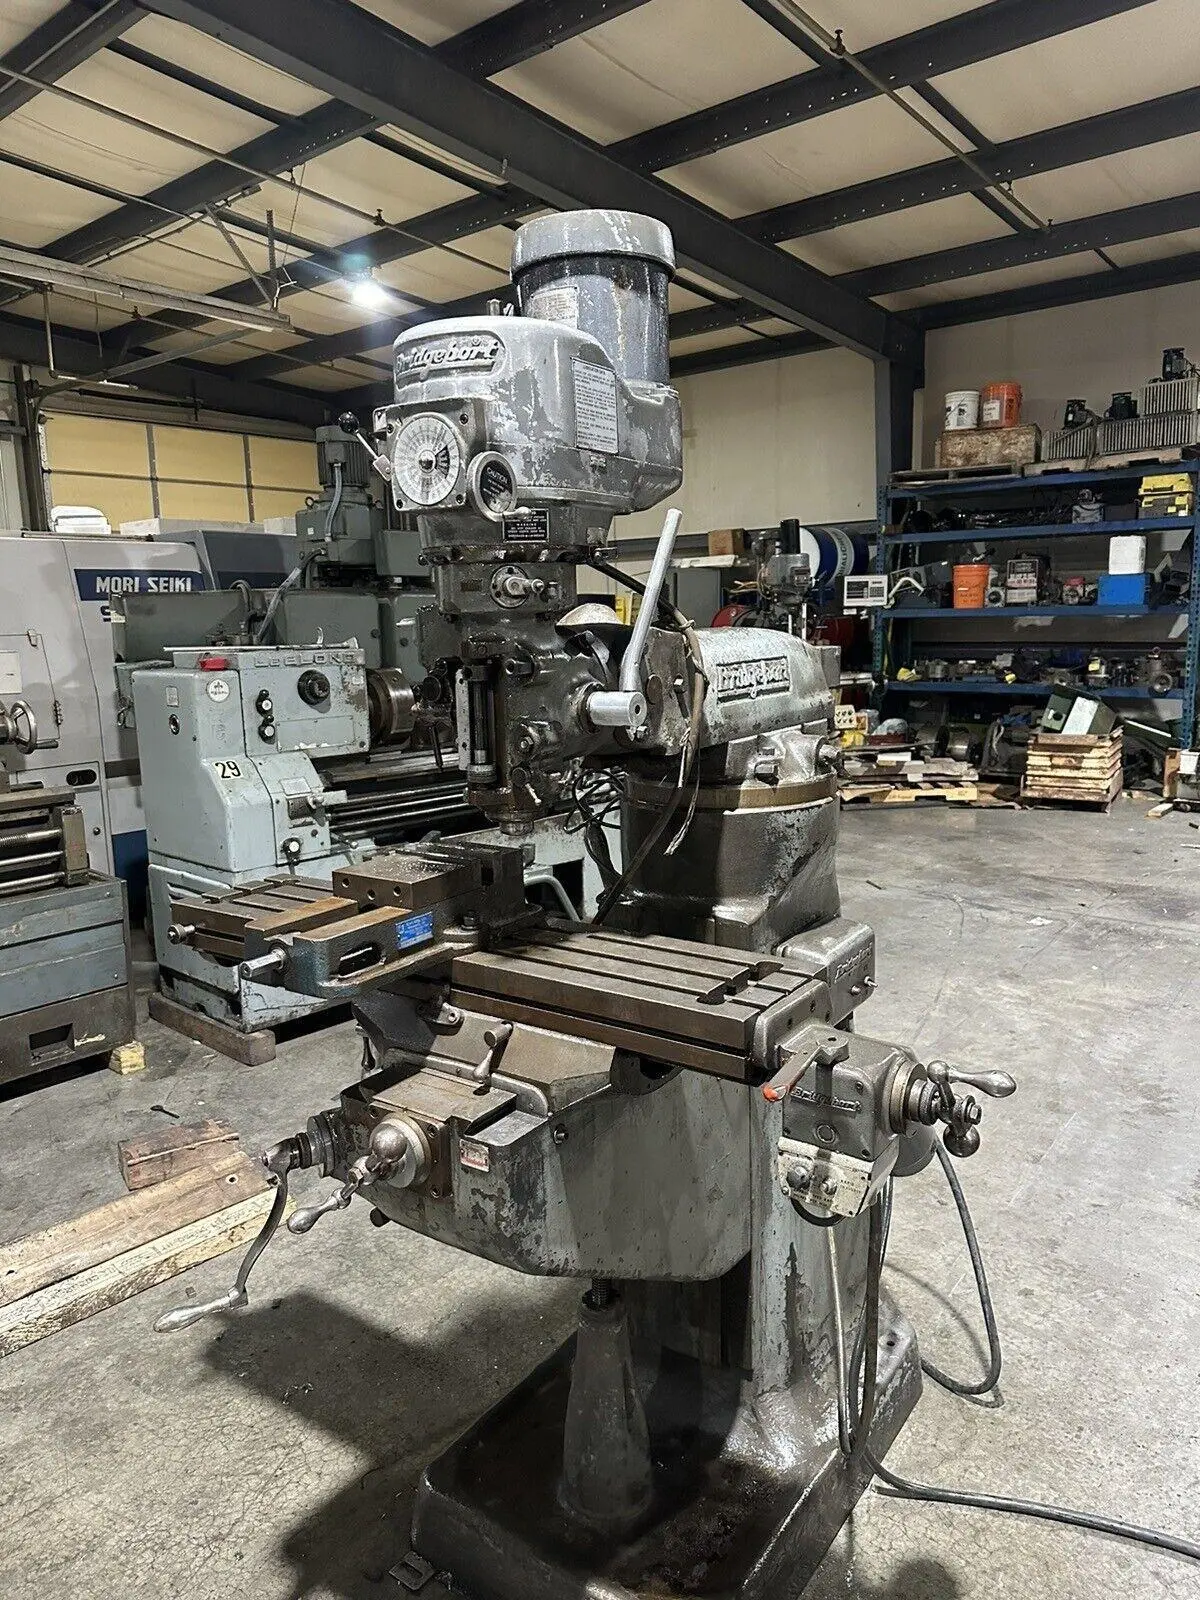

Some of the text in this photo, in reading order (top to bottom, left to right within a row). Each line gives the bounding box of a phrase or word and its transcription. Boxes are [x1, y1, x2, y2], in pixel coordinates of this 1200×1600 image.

[96, 576, 192, 593] MORI SEIKI
[214, 760, 241, 779] 29
